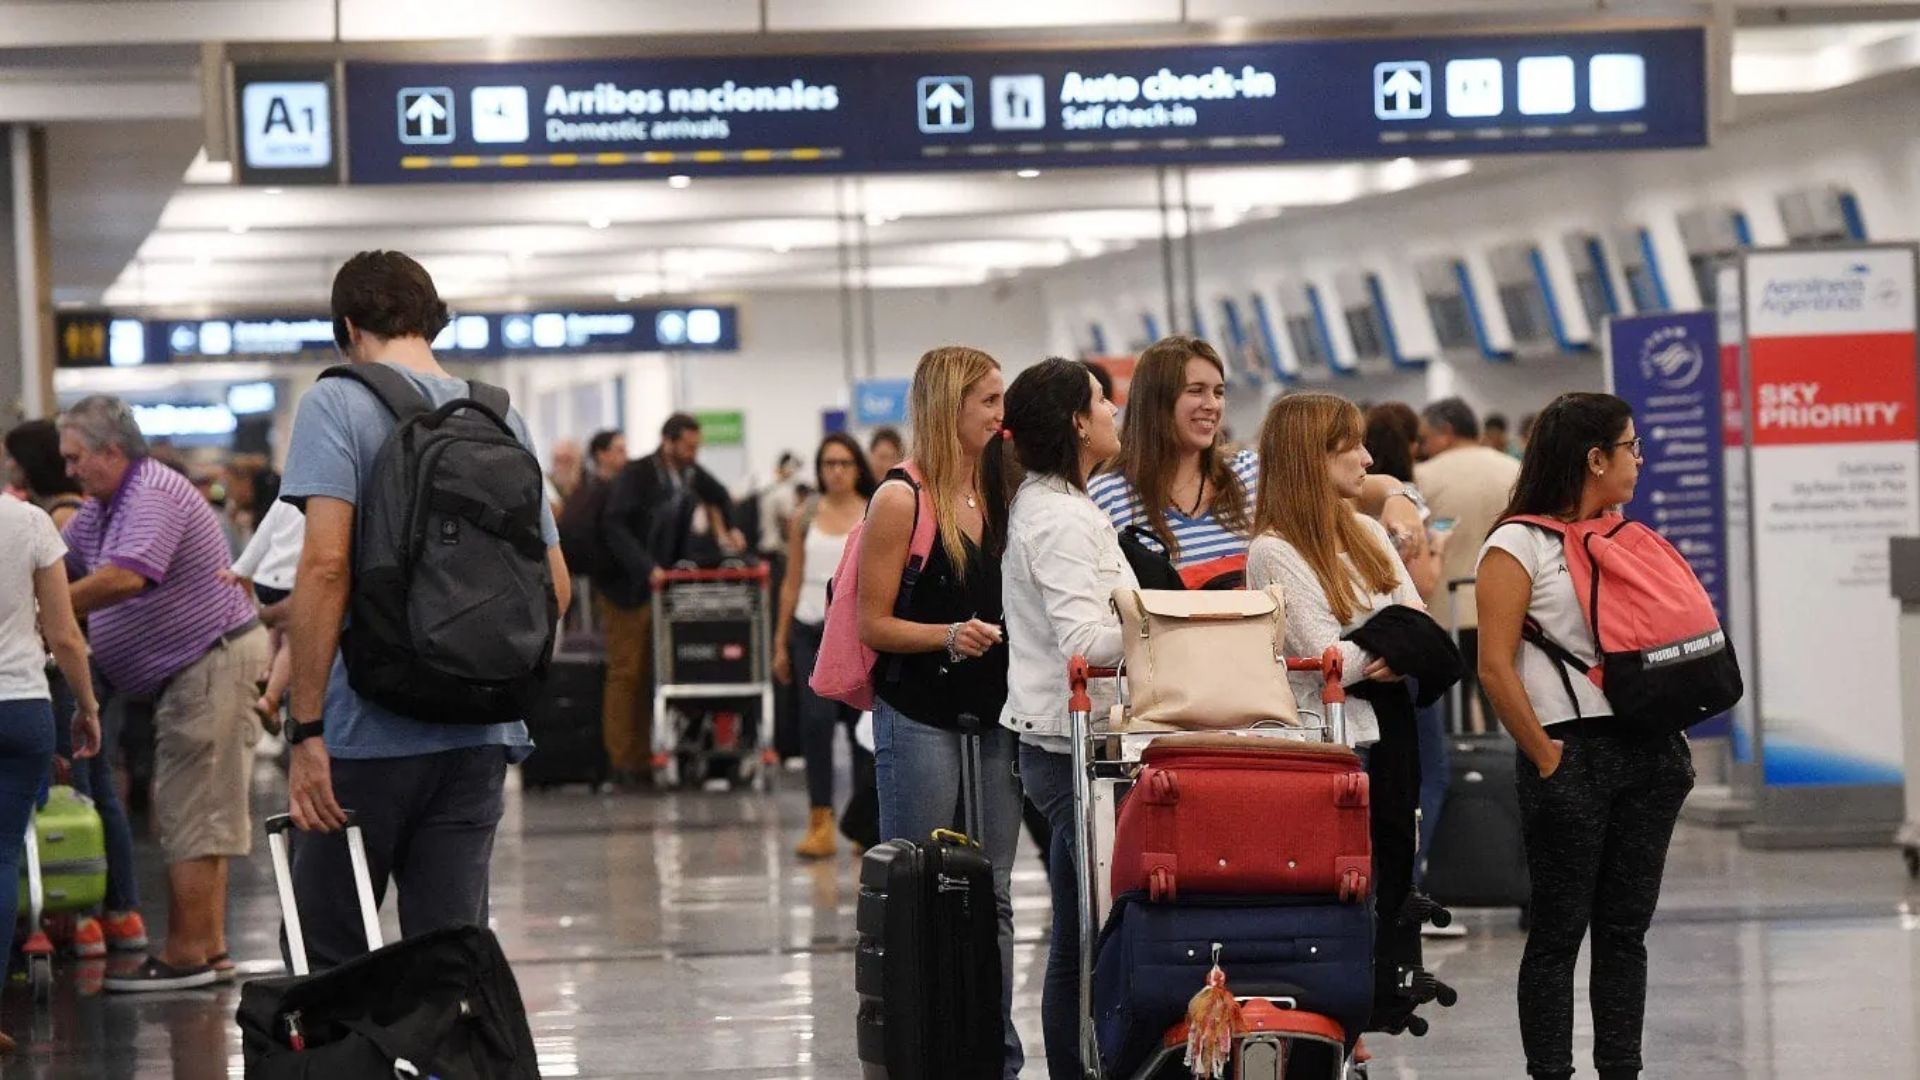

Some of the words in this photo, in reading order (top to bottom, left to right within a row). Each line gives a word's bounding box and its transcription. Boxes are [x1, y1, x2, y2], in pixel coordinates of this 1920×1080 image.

[545, 83, 665, 115] Arribos
[667, 79, 839, 112] nacionales
[1060, 72, 1140, 103] Auto
[1143, 65, 1276, 101] check-in
[546, 118, 648, 142] Domestic
[651, 116, 730, 139] arrivals
[1062, 104, 1105, 130] Self
[1105, 102, 1197, 129] check-in
[1758, 383, 1819, 405] SKY
[1758, 401, 1900, 429] PRIORITY
